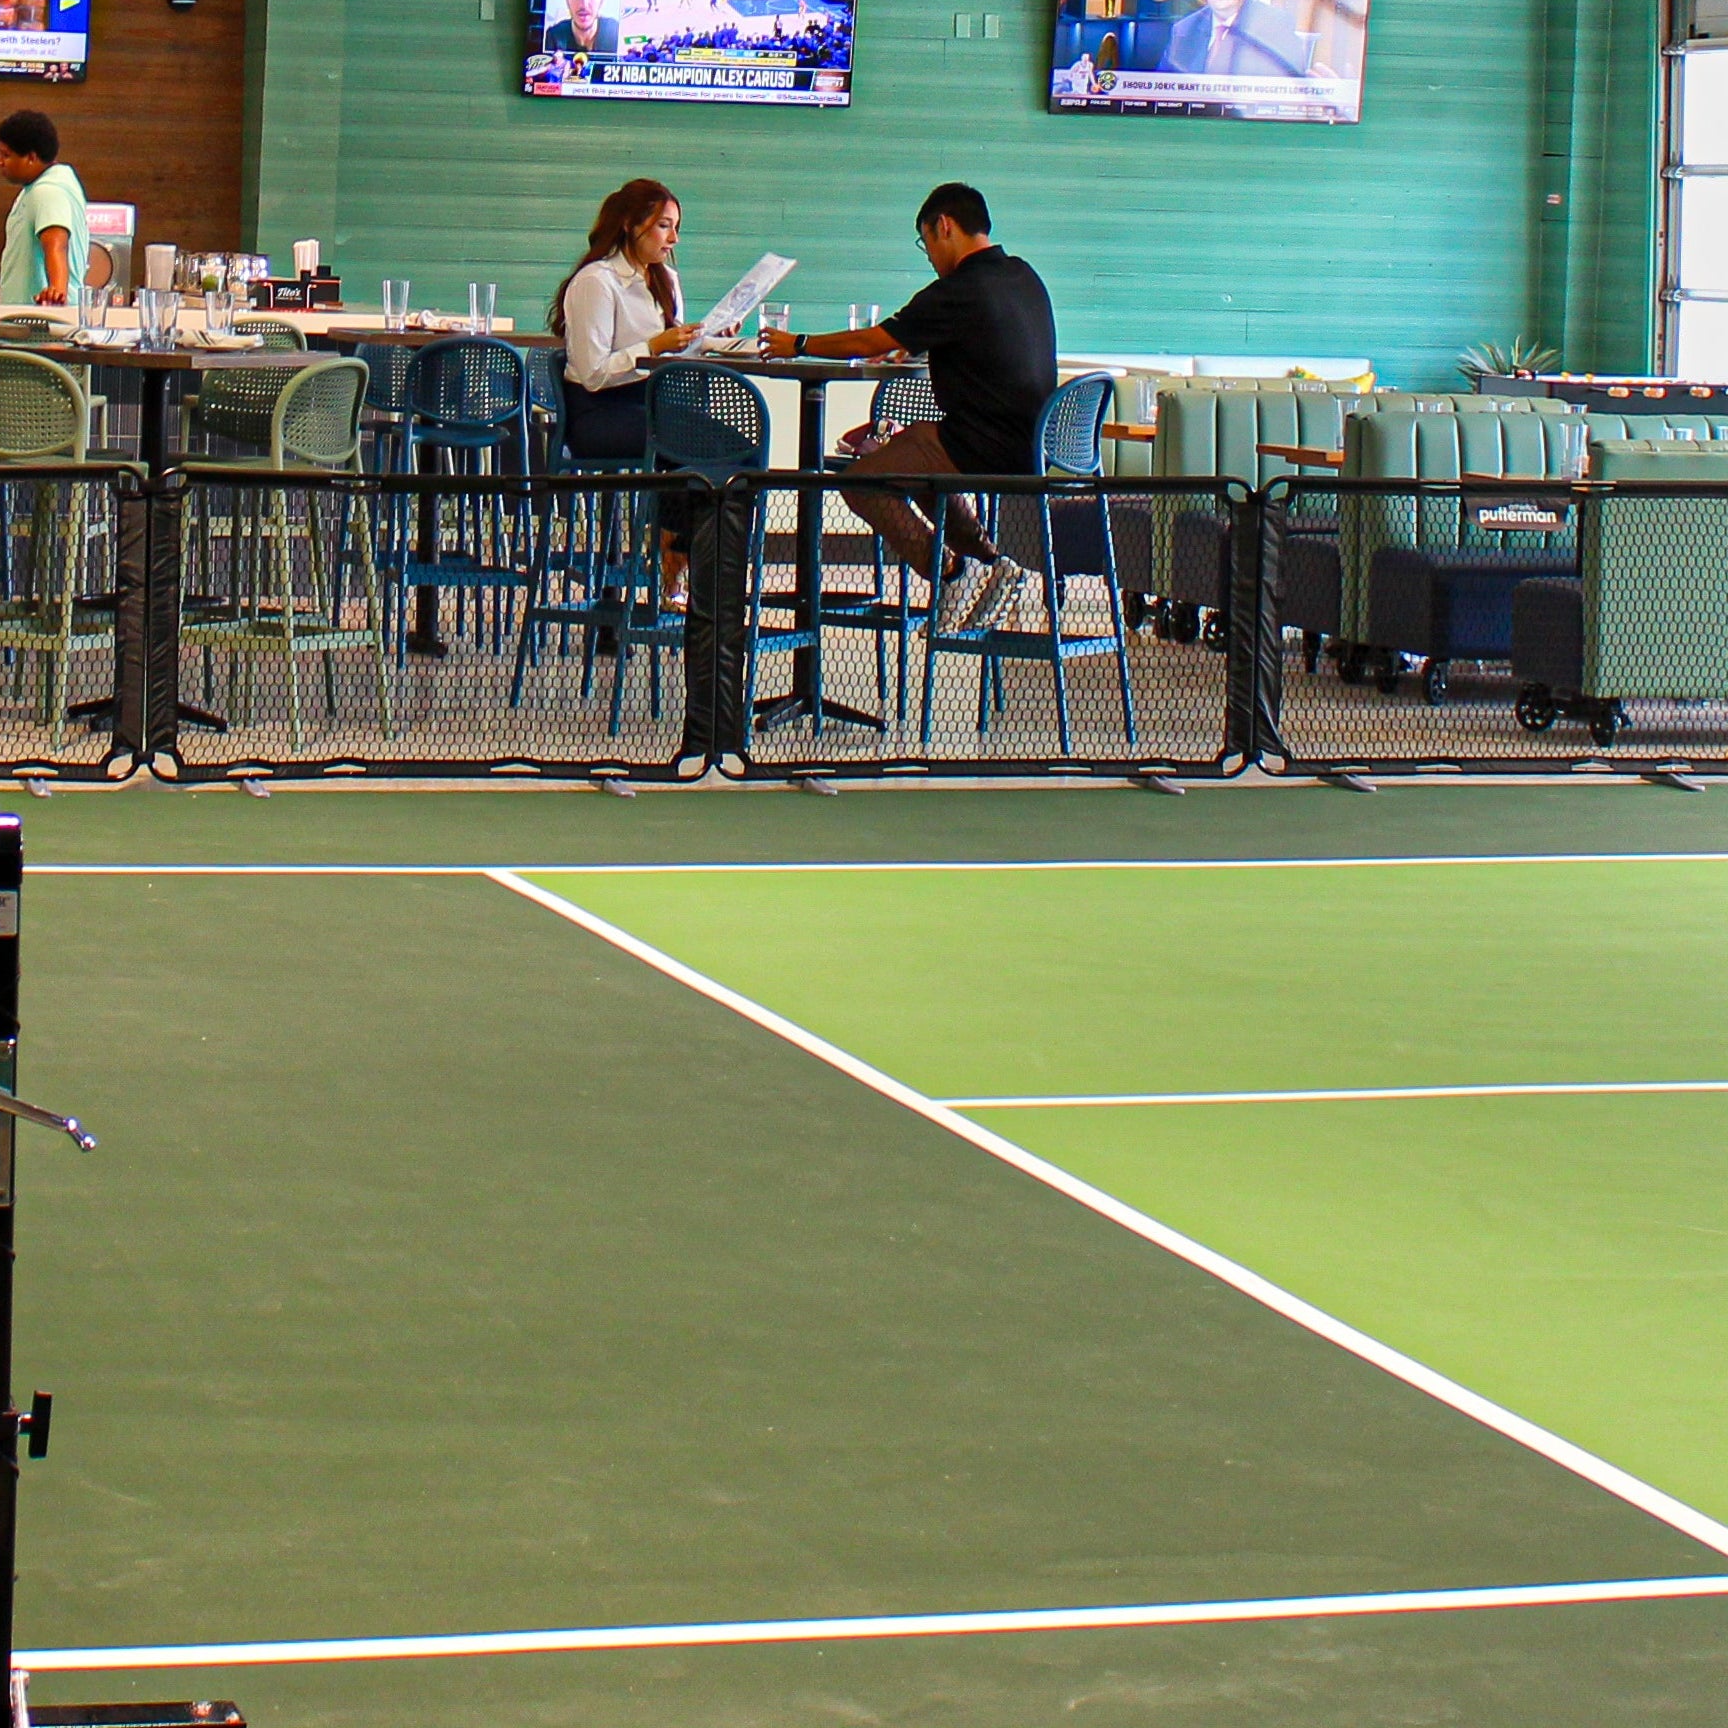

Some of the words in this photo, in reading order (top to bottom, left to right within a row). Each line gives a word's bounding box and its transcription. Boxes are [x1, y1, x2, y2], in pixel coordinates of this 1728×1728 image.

[603, 65, 621, 82] 2X
[622, 66, 647, 84] NBA
[649, 67, 712, 86] CHAMPION
[714, 69, 744, 87] ALEX
[746, 70, 795, 88] CARUSO
[277, 287, 302, 297] Tito's
[1478, 506, 1557, 523] putterman
